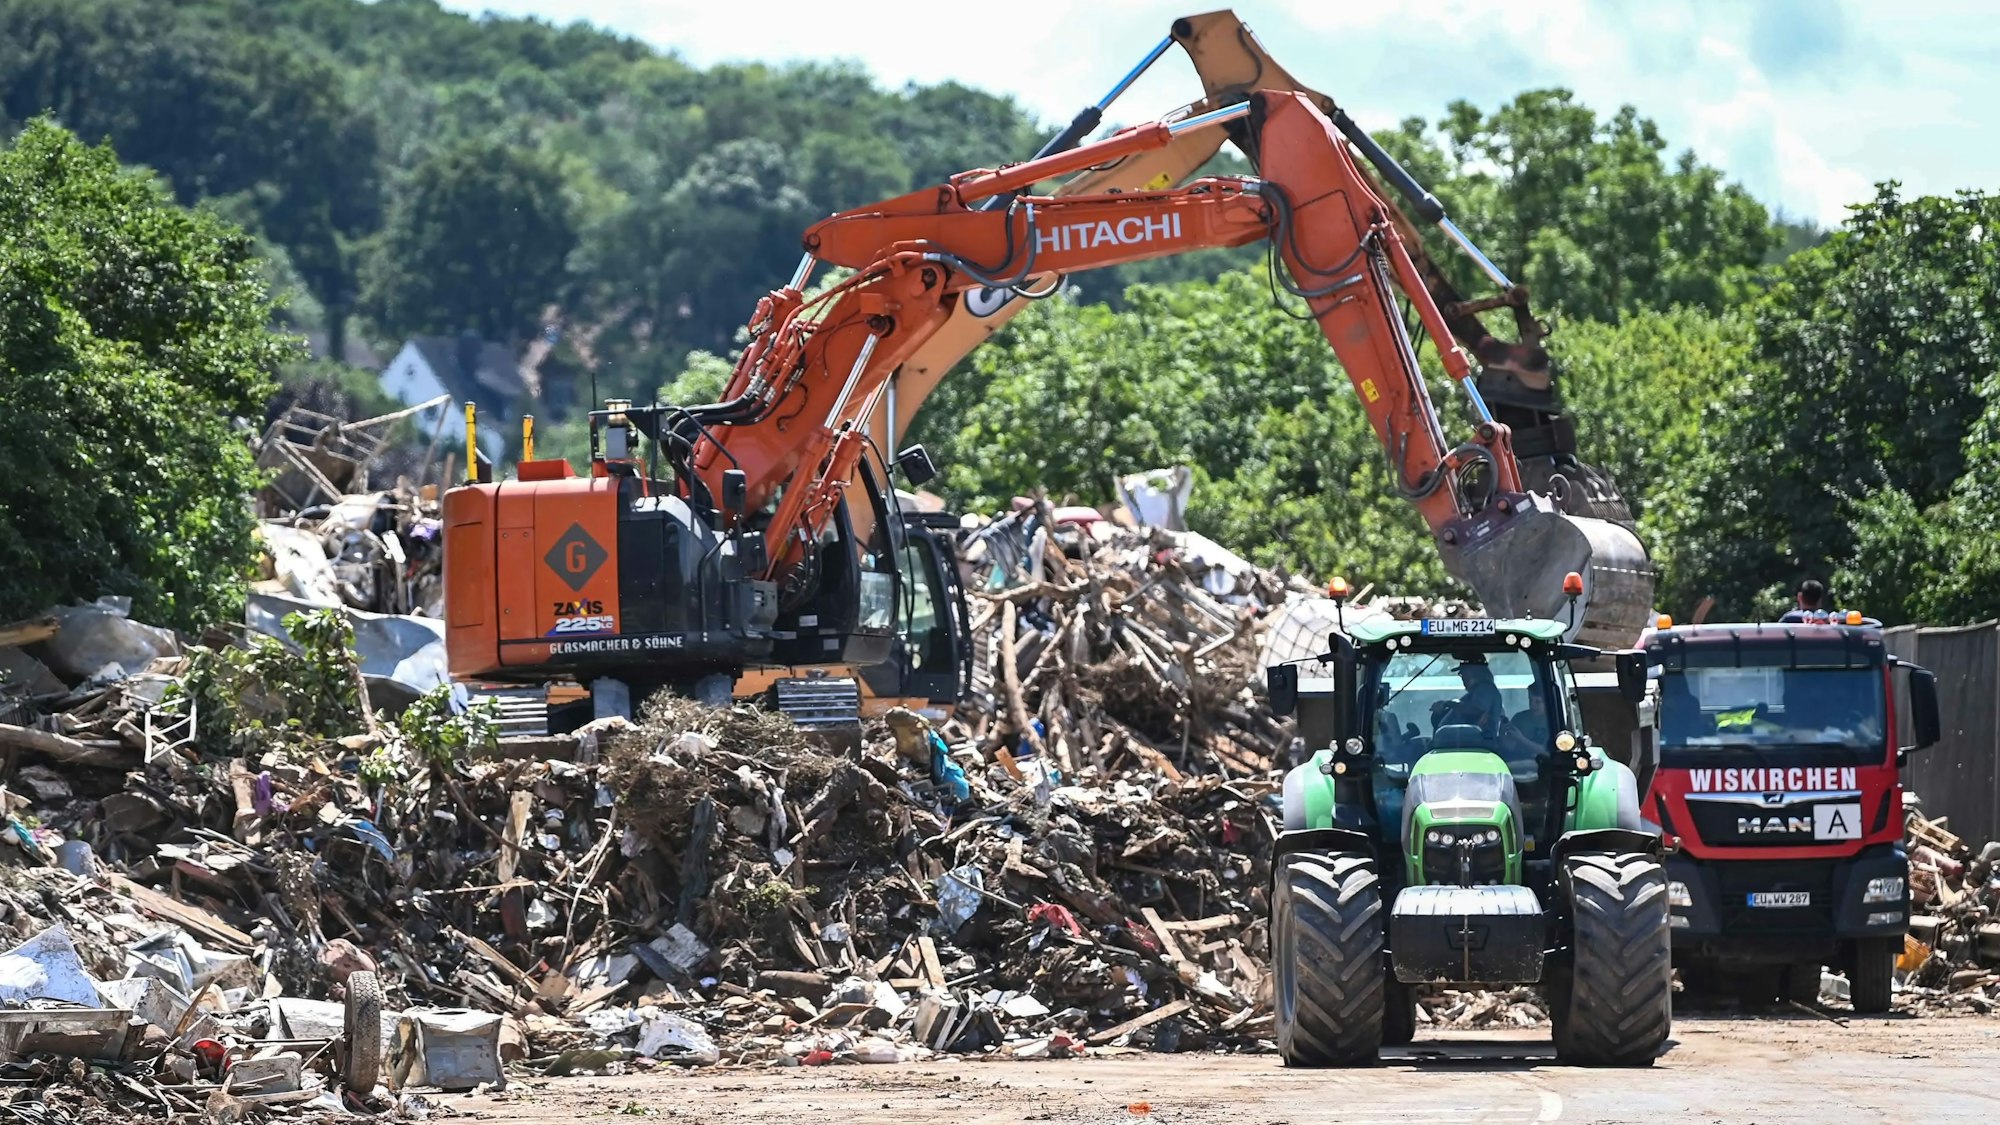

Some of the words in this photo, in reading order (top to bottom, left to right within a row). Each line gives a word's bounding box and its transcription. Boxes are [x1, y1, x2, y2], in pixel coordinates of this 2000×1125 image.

[1035, 213, 1181, 254] HITACHI
[565, 541, 587, 573] G
[553, 599, 603, 616] ZAXIS
[555, 617, 602, 632] 225
[1428, 620, 1445, 633] EU
[1452, 620, 1468, 633] MG
[1471, 620, 1493, 633] 214
[549, 640, 630, 655] GLASMACHER
[632, 638, 642, 650] &
[644, 635, 684, 650] SÖHNE
[1689, 767, 1857, 792] WISKIRCHEN
[1737, 816, 1812, 834] MAN
[1828, 808, 1849, 835] A
[1753, 893, 1767, 905] EU
[1789, 893, 1808, 904] 287
